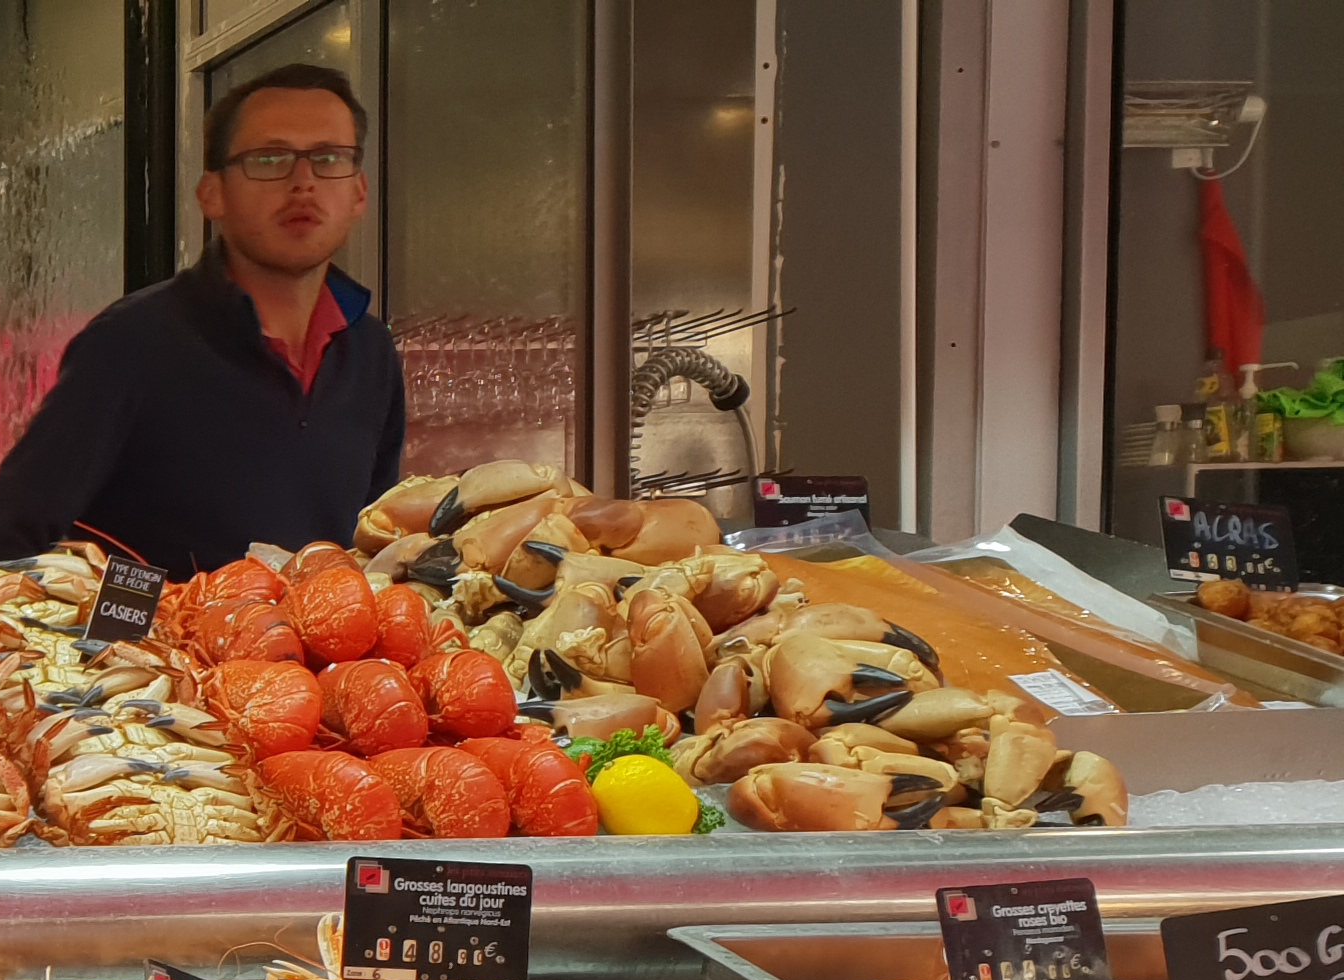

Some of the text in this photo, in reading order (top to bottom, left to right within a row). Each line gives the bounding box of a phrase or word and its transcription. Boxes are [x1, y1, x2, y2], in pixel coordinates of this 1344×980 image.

[1193, 511, 1279, 549] ACRAS
[111, 562, 128, 574] TYPE
[113, 574, 125, 585] DE
[100, 601, 148, 626] CASIERS
[394, 878, 527, 896] Grosses langoustines
[419, 893, 505, 911] cuites du jour
[992, 905, 1035, 918] Grosses
